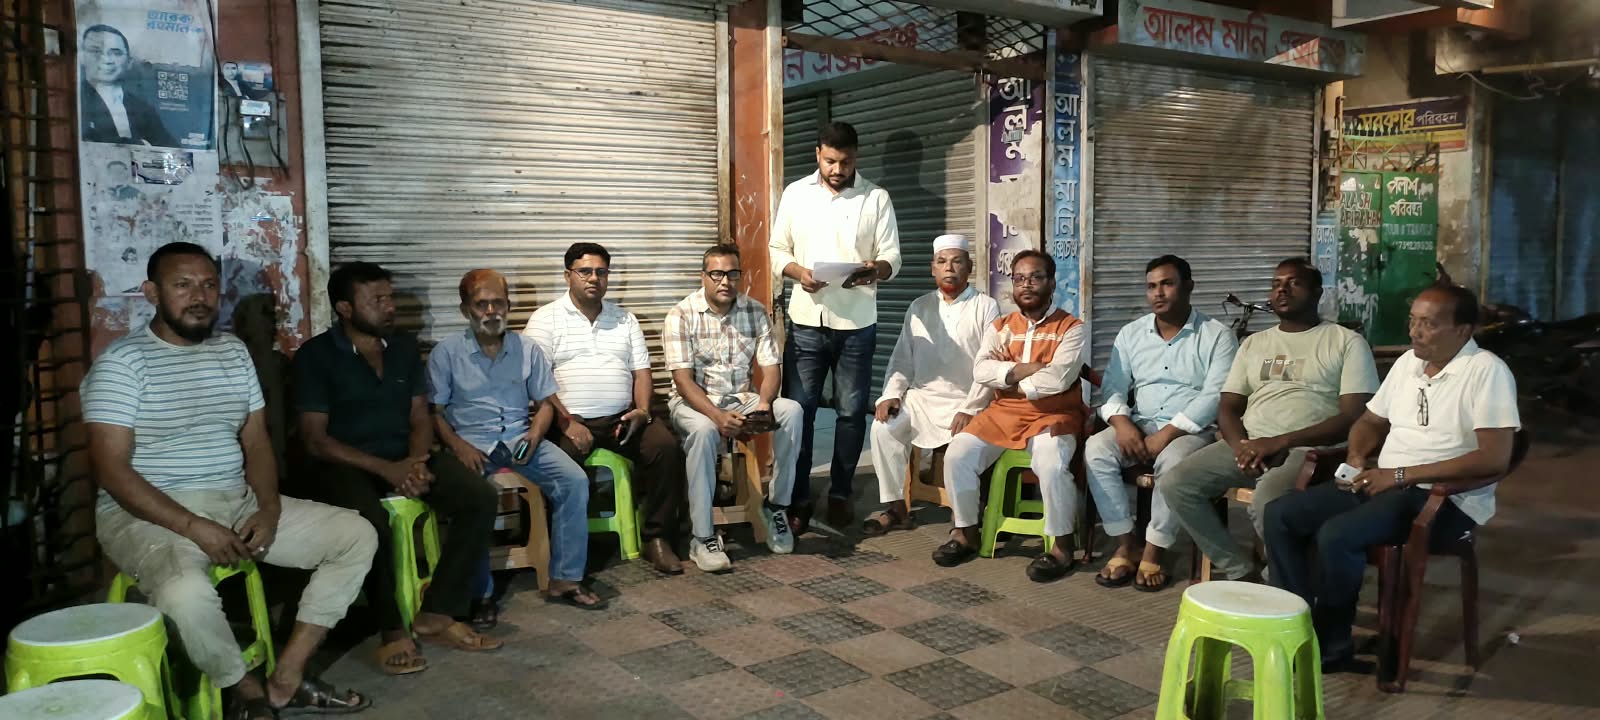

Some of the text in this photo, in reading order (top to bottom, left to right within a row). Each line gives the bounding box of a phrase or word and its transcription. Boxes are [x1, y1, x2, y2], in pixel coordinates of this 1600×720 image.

[1143, 6, 1215, 48] আলম
[1222, 10, 1268, 55] মানি
[1359, 109, 1416, 131] সরকার
[1416, 111, 1457, 126] পরিবহন
[1387, 176, 1419, 196] পলাশ
[1389, 198, 1423, 217] পরিবহন
